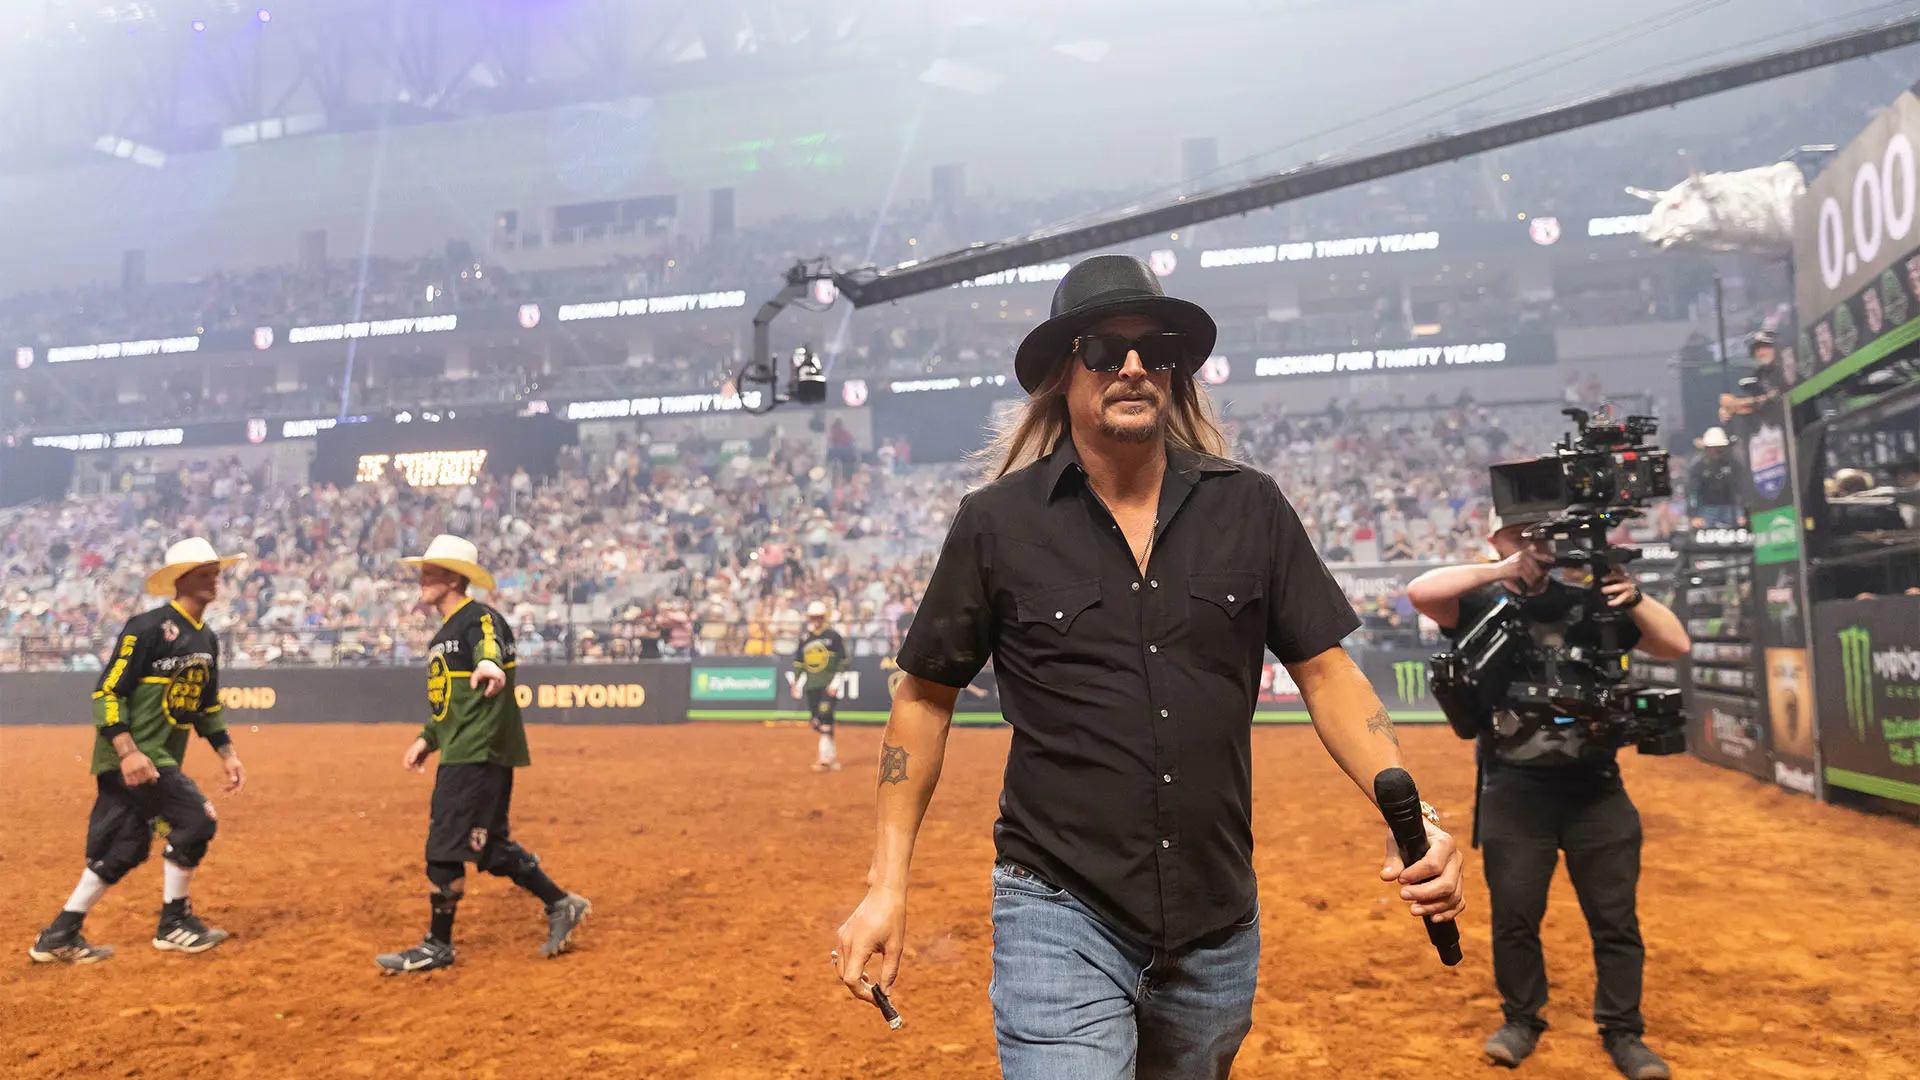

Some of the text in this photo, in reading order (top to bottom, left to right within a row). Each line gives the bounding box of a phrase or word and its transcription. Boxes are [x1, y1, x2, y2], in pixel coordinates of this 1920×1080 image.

[1819, 134, 1915, 289] 0.00
[1278, 243, 1313, 261] FOR
[1380, 232, 1438, 252] YEARS
[1337, 351, 1373, 370] FOR
[1444, 343, 1505, 364] YEARS
[538, 684, 645, 708] BEYOND
